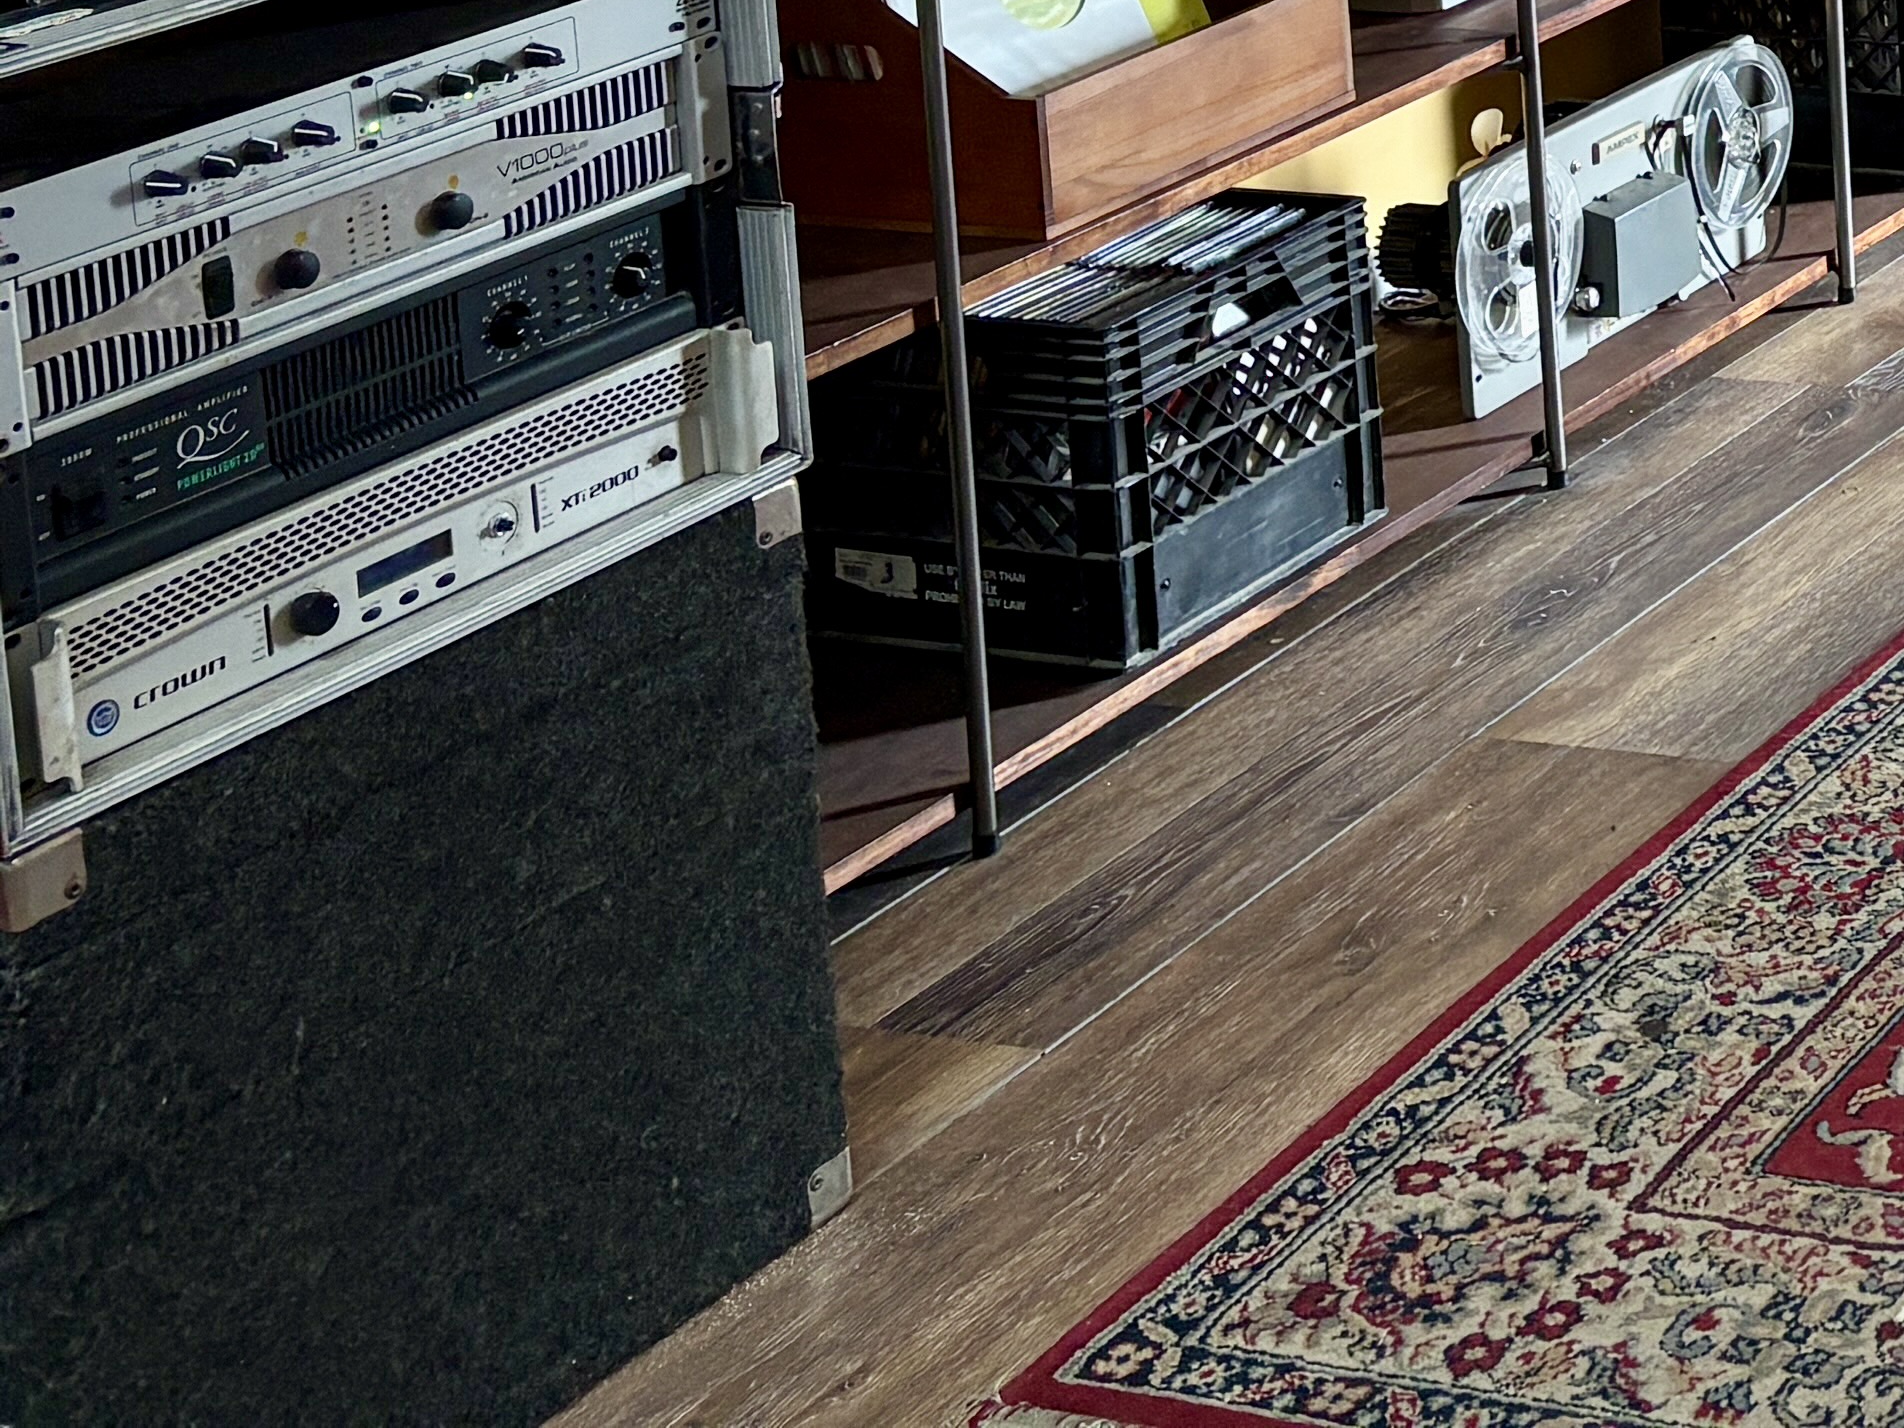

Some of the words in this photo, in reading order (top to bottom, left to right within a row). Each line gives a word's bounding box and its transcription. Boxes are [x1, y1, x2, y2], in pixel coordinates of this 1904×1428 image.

[115, 409, 189, 444] PROFESSIONAL
[195, 383, 249, 412] AMPLIFIER
[175, 407, 240, 470] QSC
[561, 488, 587, 512] XTi
[589, 464, 639, 499] 2000
[924, 563, 945, 576] USE
[999, 570, 1026, 583] THAN
[1003, 599, 1026, 611] LAW
[133, 655, 226, 710] crown
